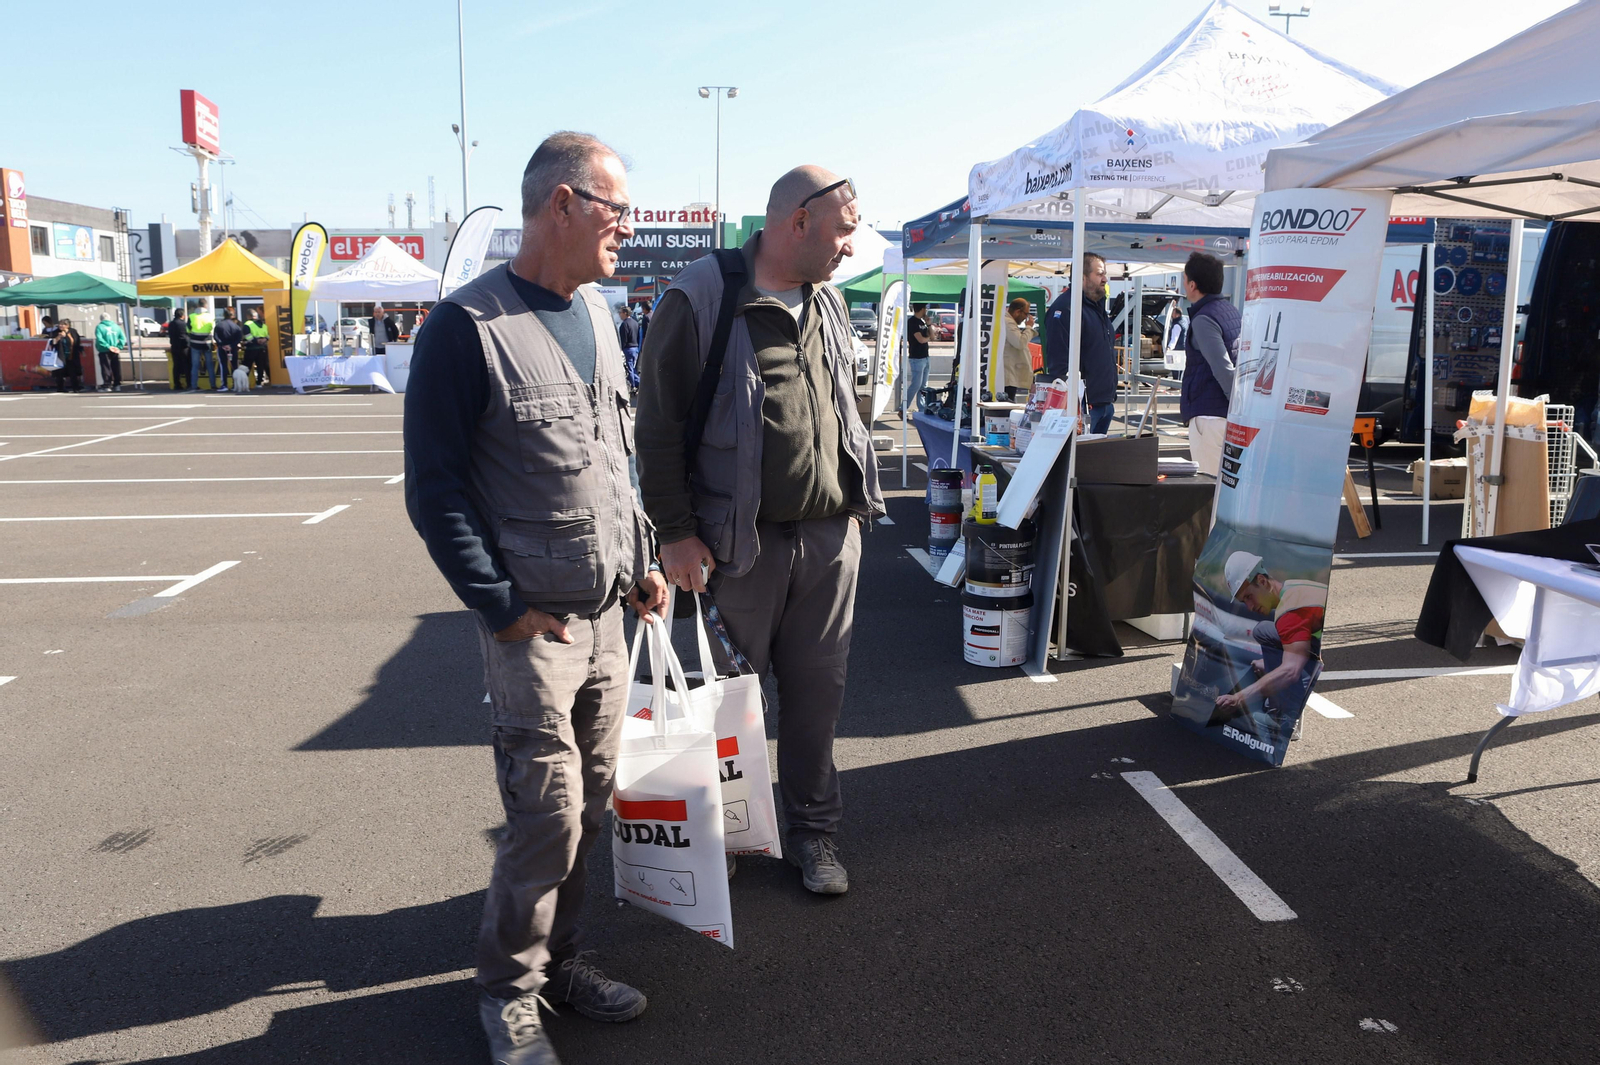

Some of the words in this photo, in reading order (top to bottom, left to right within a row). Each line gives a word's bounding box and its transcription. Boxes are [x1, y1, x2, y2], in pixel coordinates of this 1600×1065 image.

[1106, 158, 1153, 171] BAIXENS
[1132, 175, 1167, 183] DIFFERENCE
[630, 206, 722, 222] taurante
[1260, 207, 1367, 232] BOND007
[334, 237, 353, 255] el
[356, 235, 420, 259] jaón
[487, 235, 518, 252] RIAS
[619, 234, 662, 248] NAMI
[666, 234, 711, 248] SUSHI
[1285, 235, 1308, 245] PARA
[1309, 236, 1339, 246] EPDM
[299, 233, 315, 276] weber
[615, 260, 653, 269] BUFFET
[661, 260, 692, 269] CART
[1231, 728, 1275, 754] Rollgum
[720, 760, 743, 783] AL
[613, 814, 691, 849] OUDAL
